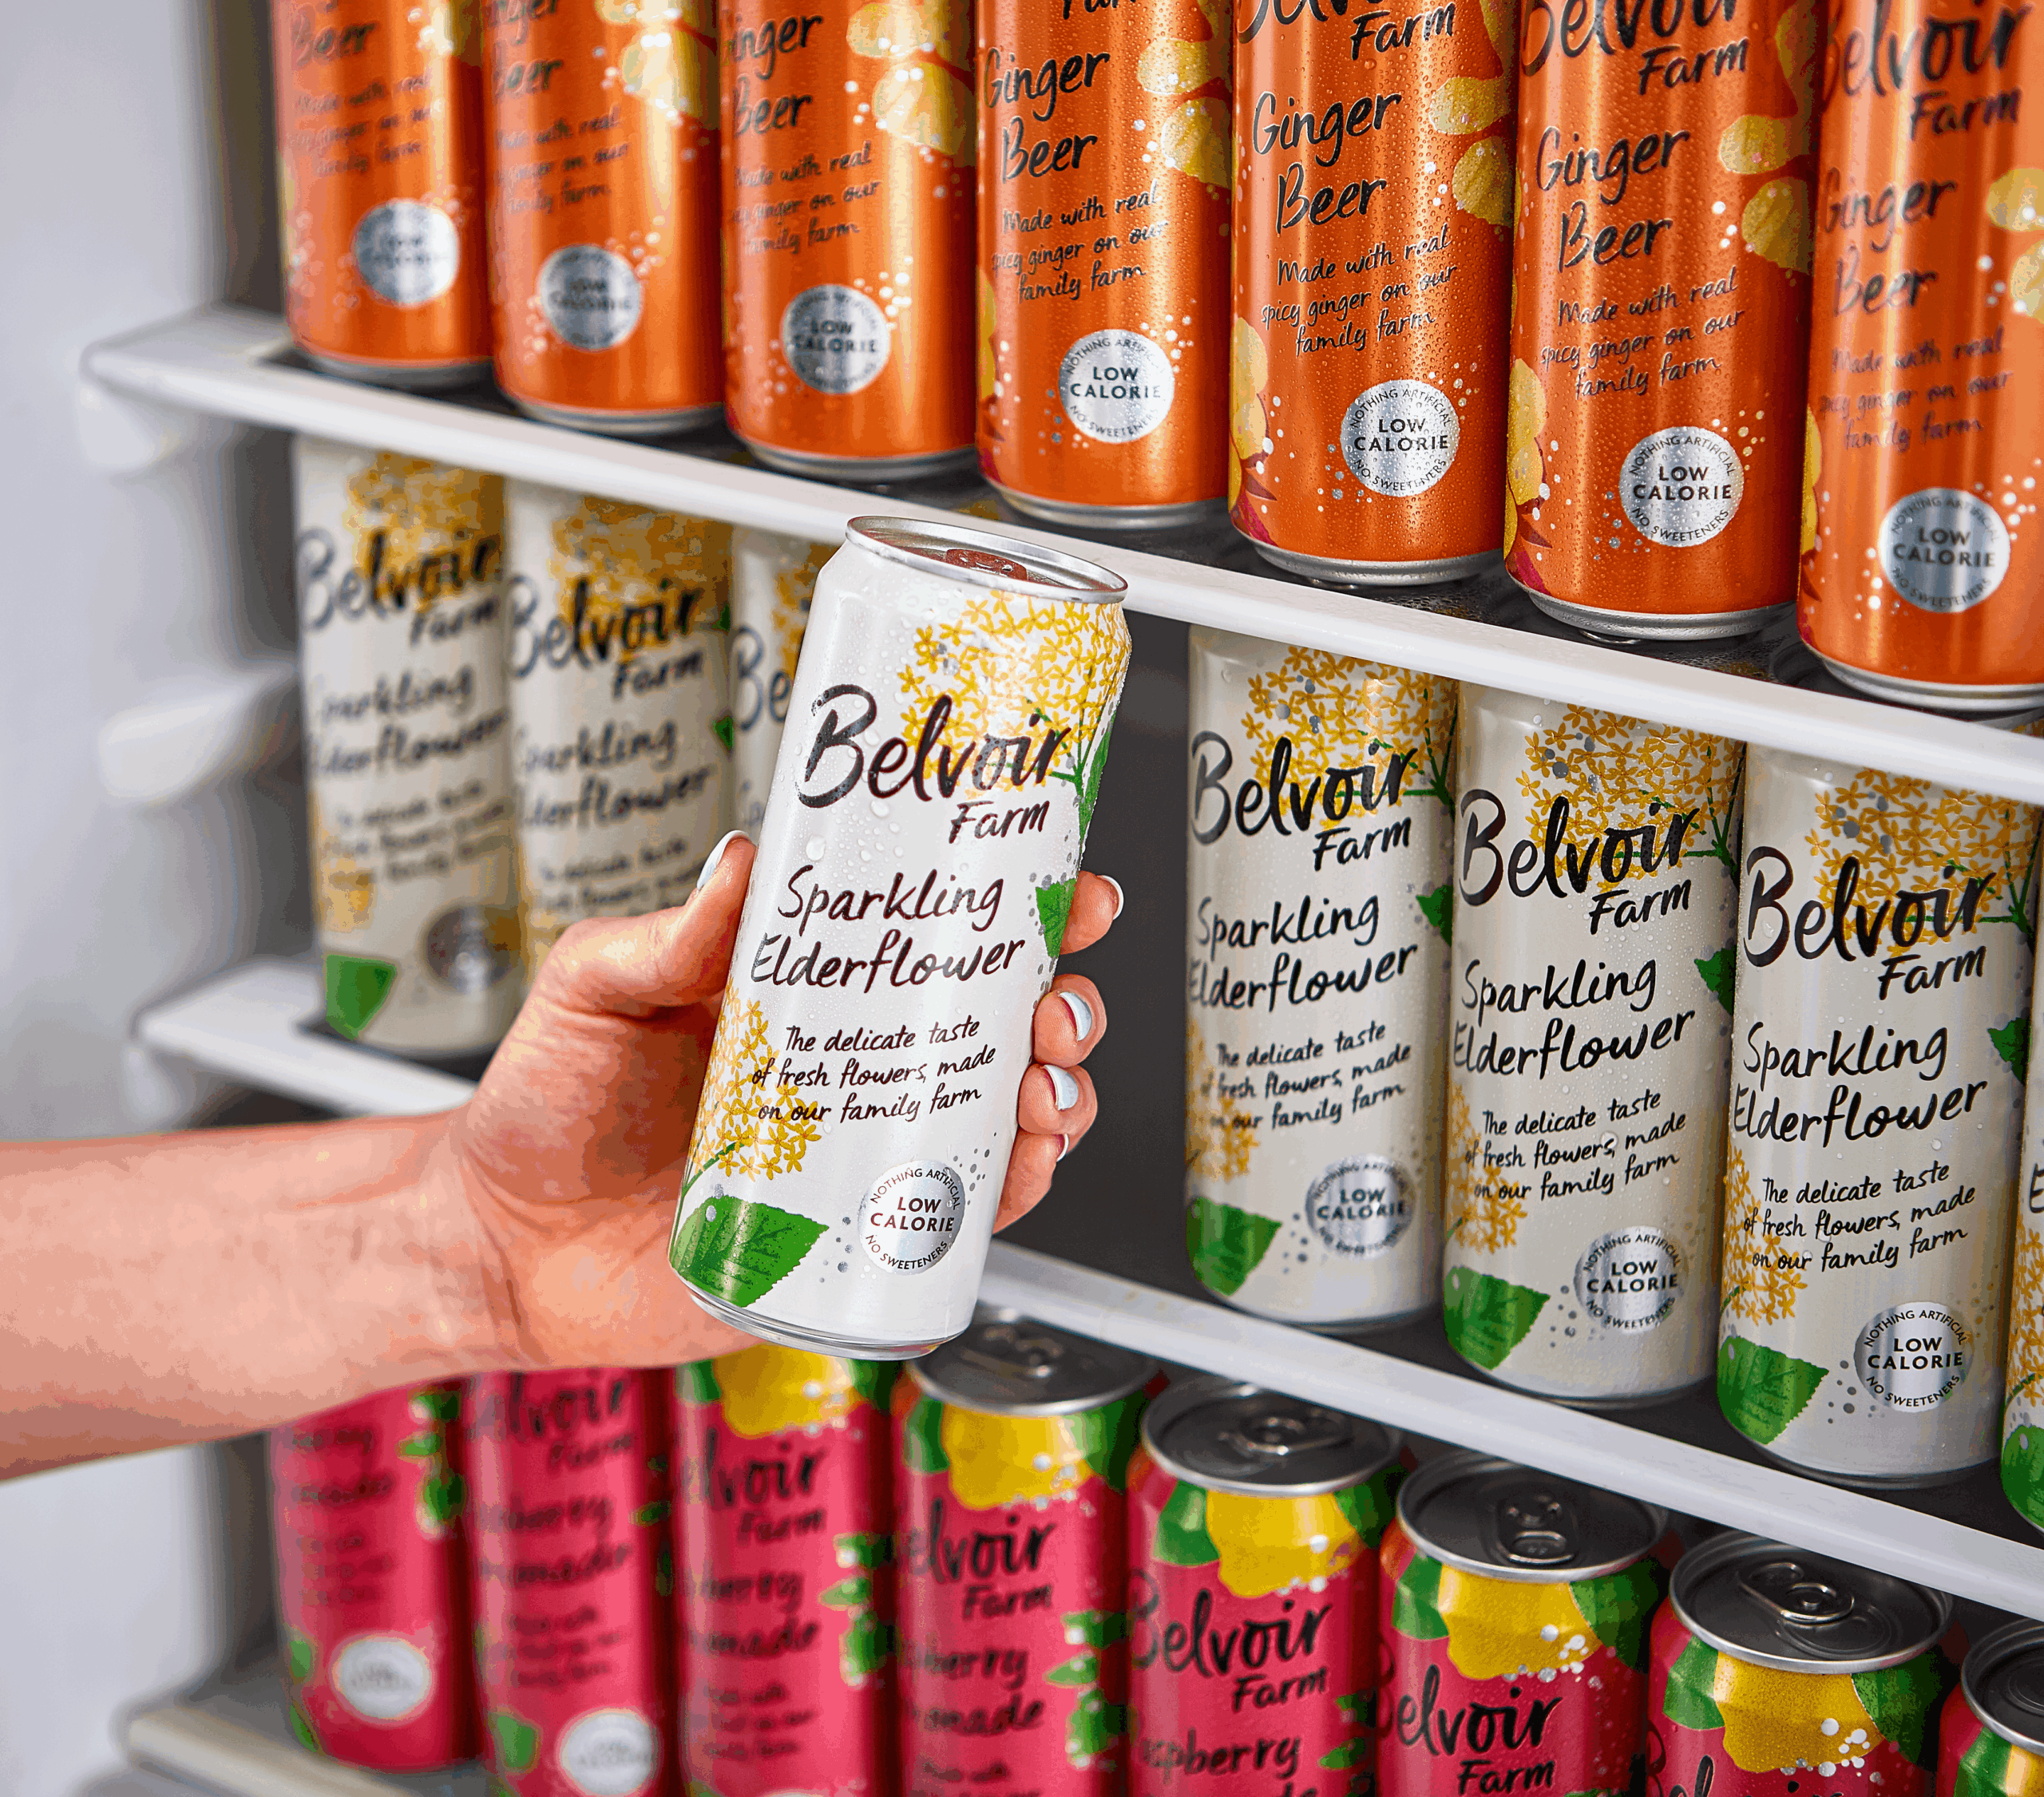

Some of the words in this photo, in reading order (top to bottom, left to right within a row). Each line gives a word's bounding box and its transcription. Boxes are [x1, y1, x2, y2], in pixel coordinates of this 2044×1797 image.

[729, 14, 823, 81] inger
[1350, 2, 1455, 61] Farm
[984, 47, 1110, 121] Ginger
[1638, 37, 1749, 95] Farm
[1253, 91, 1402, 167] Ginger
[1910, 85, 2022, 141] Farm
[781, 152, 822, 181] with
[829, 140, 872, 172] real
[1002, 116, 1098, 184] Beer
[1537, 126, 1690, 206] Ginger
[810, 193, 835, 210] on
[842, 180, 883, 201] our
[1003, 208, 1053, 234] Made
[1060, 196, 1107, 225] with
[1115, 178, 1163, 214] real
[1276, 162, 1387, 235] Beer
[1824, 167, 1958, 252] Ginger
[808, 216, 860, 246] farm
[1028, 242, 1085, 275] ginger
[1094, 236, 1121, 253] on
[1129, 220, 1168, 244] our
[1559, 200, 1674, 273] Beer
[1278, 258, 1337, 286] Made
[1346, 242, 1396, 274] with
[1405, 223, 1452, 260] real
[1019, 271, 1081, 304] family
[1091, 260, 1146, 291] farm
[1262, 303, 1301, 330] spicy
[1308, 291, 1372, 327] ginger
[1381, 283, 1411, 301] on
[1418, 265, 1458, 291] our
[1559, 299, 1618, 327] Made
[1629, 283, 1681, 316] with
[1690, 266, 1739, 308] real
[1834, 244, 1938, 316] Beer
[793, 338, 877, 353] CALORIE
[810, 320, 853, 334] LOW
[1297, 323, 1366, 359] family
[1377, 308, 1436, 342] farm
[1541, 343, 1580, 371] spicy
[1588, 334, 1654, 369] ginger
[1665, 324, 1695, 346] on
[1704, 308, 1745, 336] our
[1070, 382, 1161, 399] CALORIE
[1093, 367, 1138, 381] LOW
[1575, 366, 1648, 400] family
[1660, 353, 1721, 387] farm
[1967, 370, 2014, 395] our
[1350, 389, 1398, 428] NOTHING
[1402, 389, 1452, 427] ARTIFICIAL
[1379, 418, 1425, 433] LOW
[1920, 410, 1983, 444] farm
[1354, 435, 1448, 451] CALORIE
[1629, 435, 1681, 476] NOTHING
[1685, 437, 1737, 476] ARTIFICIAL
[1354, 460, 1371, 478] NO
[1373, 460, 1446, 491] SWEETENERS
[1633, 484, 1731, 501] CALORIE
[1659, 466, 1709, 481] LOW
[1632, 507, 1650, 526] NO
[1652, 509, 1729, 541] SWEETENERS
[1918, 528, 1971, 546] LOW
[1892, 544, 1995, 568] CALORIE
[298, 528, 504, 633] Belvoir
[507, 574, 704, 679] Belvoir
[612, 648, 704, 699] Farm
[517, 721, 676, 774] parkling
[794, 683, 1072, 809] Belvoir
[1191, 730, 1418, 846] Belvoir
[949, 800, 1049, 845] Farm
[1313, 817, 1412, 872] Farm
[1460, 789, 1700, 906] Belvoir
[778, 864, 1004, 936] Sparkling
[1589, 879, 1692, 935] Farm
[1744, 845, 1996, 967] Belvoir
[1198, 895, 1379, 962] Sparkling
[751, 928, 1025, 994] Elderflower
[1187, 944, 1418, 1019] Elderflower
[1878, 945, 1987, 1000] Farm
[1462, 959, 1656, 1027] Sparkling
[786, 1026, 815, 1051] The
[824, 1024, 916, 1051] delicate
[929, 1015, 980, 1044] taste
[1246, 1037, 1324, 1066] delicate
[1336, 1020, 1386, 1054] taste
[1453, 1010, 1695, 1080] Elderflower
[752, 1057, 775, 1088] of
[777, 1057, 830, 1088] fresh
[839, 1059, 927, 1089] flowers,
[937, 1045, 996, 1077] made
[1352, 1043, 1411, 1079] made
[1743, 1022, 1947, 1092] Sparkling
[758, 1103, 782, 1120] on
[790, 1103, 832, 1121] our
[841, 1092, 921, 1123] family
[929, 1082, 983, 1114] farm
[1272, 1098, 1342, 1130] family
[1353, 1084, 1406, 1114] farm
[1483, 1110, 1507, 1135] The
[1516, 1105, 1597, 1135] delicate
[1607, 1089, 1661, 1122] taste
[1733, 1081, 1988, 1148] Elderflower
[1483, 1141, 1525, 1169] fresh
[1535, 1141, 1616, 1169] flowers,
[1626, 1113, 1686, 1150] made
[871, 1168, 922, 1204] NOTHING
[925, 1168, 961, 1211] ARTIFICIAL
[1340, 1188, 1386, 1204] LOW
[1475, 1183, 1490, 1197] on
[1499, 1184, 1531, 1199] our
[1541, 1167, 1614, 1201] family
[1625, 1154, 1681, 1185] farm
[1763, 1178, 1788, 1203] The
[1796, 1176, 1882, 1204] delicate
[1893, 1161, 1950, 1193] taste
[870, 1212, 955, 1233] CALORIE
[897, 1197, 941, 1213] LOW
[1317, 1201, 1404, 1220] CALORIE
[1744, 1207, 1758, 1235] of
[1763, 1209, 1806, 1237] fresh
[1816, 1209, 1900, 1239] flowers,
[1911, 1185, 1975, 1223] made
[865, 1234, 881, 1253] NO
[880, 1241, 948, 1270] SWEETENERS
[1583, 1234, 1631, 1273] NOTHING
[1635, 1233, 1682, 1267] ARTIFICIAL
[1612, 1260, 1658, 1277] LOW
[1753, 1252, 1772, 1267] on
[1777, 1255, 1812, 1270] our
[1821, 1240, 1899, 1272] family
[1910, 1227, 1968, 1259] farm
[1586, 1273, 1678, 1294] CALORIE
[1586, 1300, 1604, 1317] NO
[1864, 1311, 1915, 1348] NOTHING
[1919, 1310, 1967, 1345] ARTIFICIAL
[1868, 1352, 1963, 1369] CALORIE
[1894, 1337, 1943, 1352] LOW
[1867, 1375, 1884, 1395] NO
[1885, 1375, 1959, 1407] SWEETENERS
[962, 1583, 1052, 1622] Farm
[1131, 1567, 1333, 1677] Belvoir
[1233, 1668, 1327, 1712] Farm
[1458, 1759, 1555, 1795] Farm
